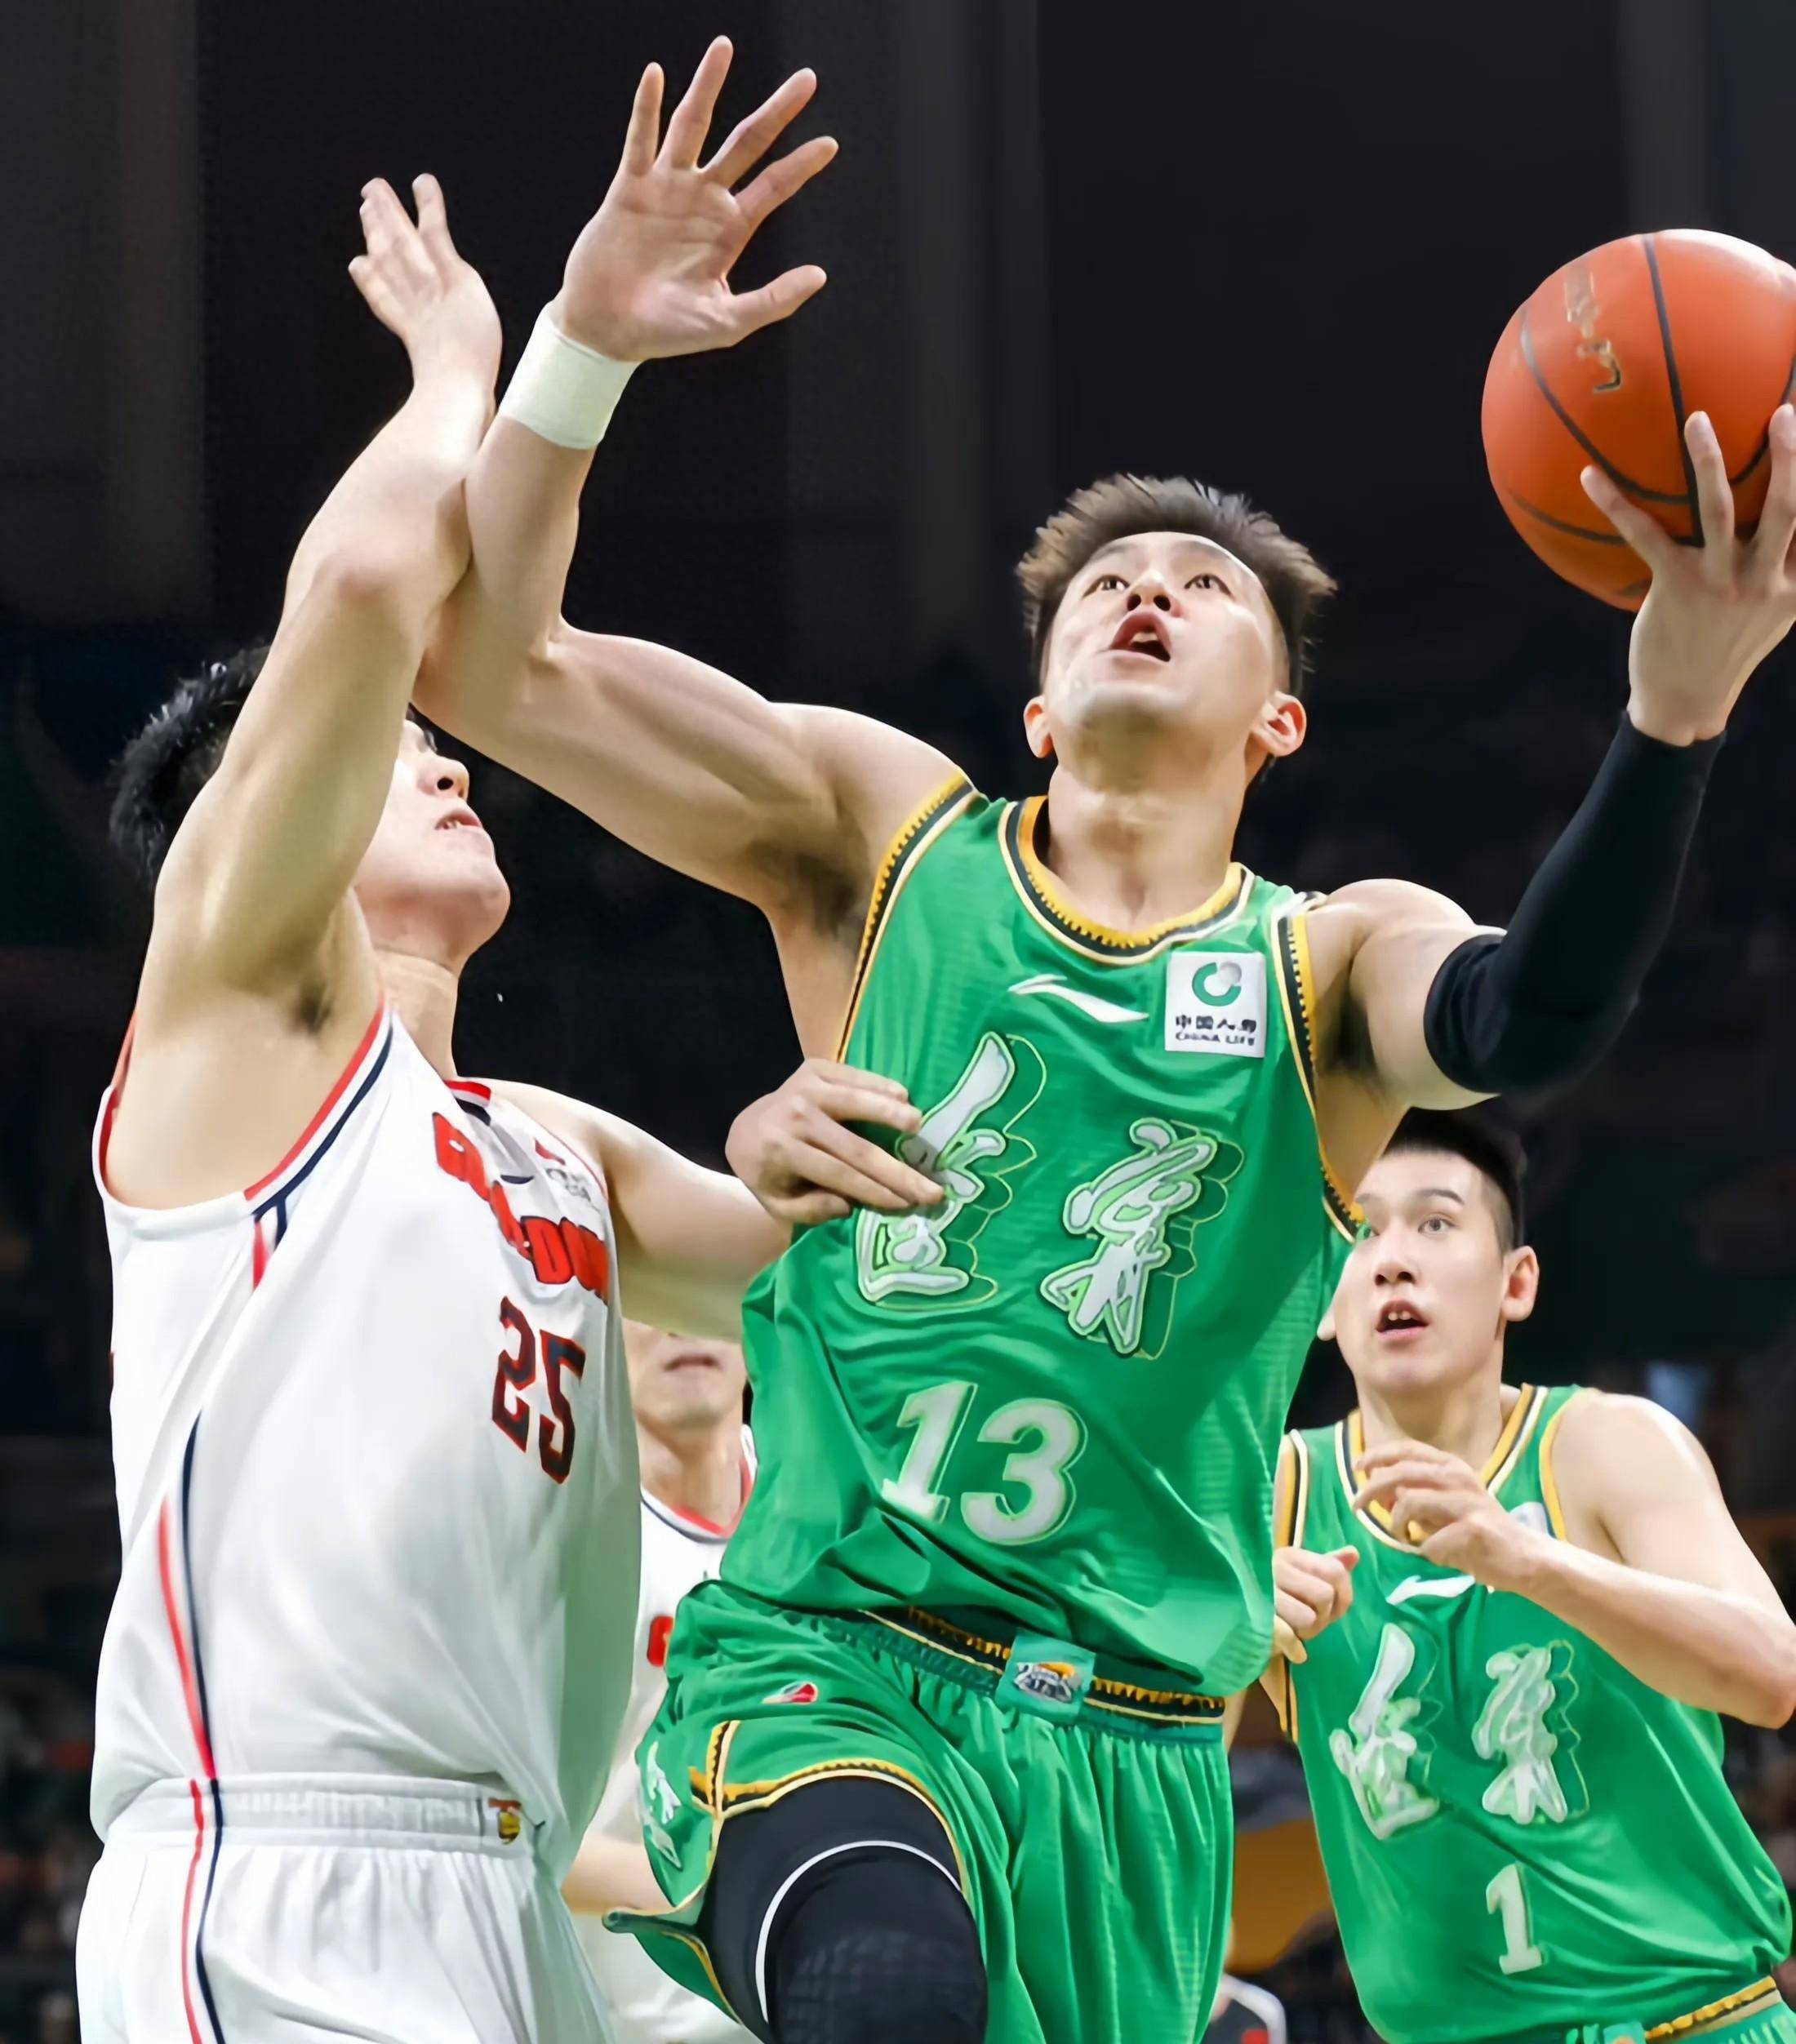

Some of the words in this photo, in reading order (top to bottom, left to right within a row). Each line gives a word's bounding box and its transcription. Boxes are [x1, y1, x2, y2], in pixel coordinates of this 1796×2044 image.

[491, 1296, 586, 1484] 25
[881, 1380, 1089, 1546] 13
[1485, 1862, 1543, 1975] 1
